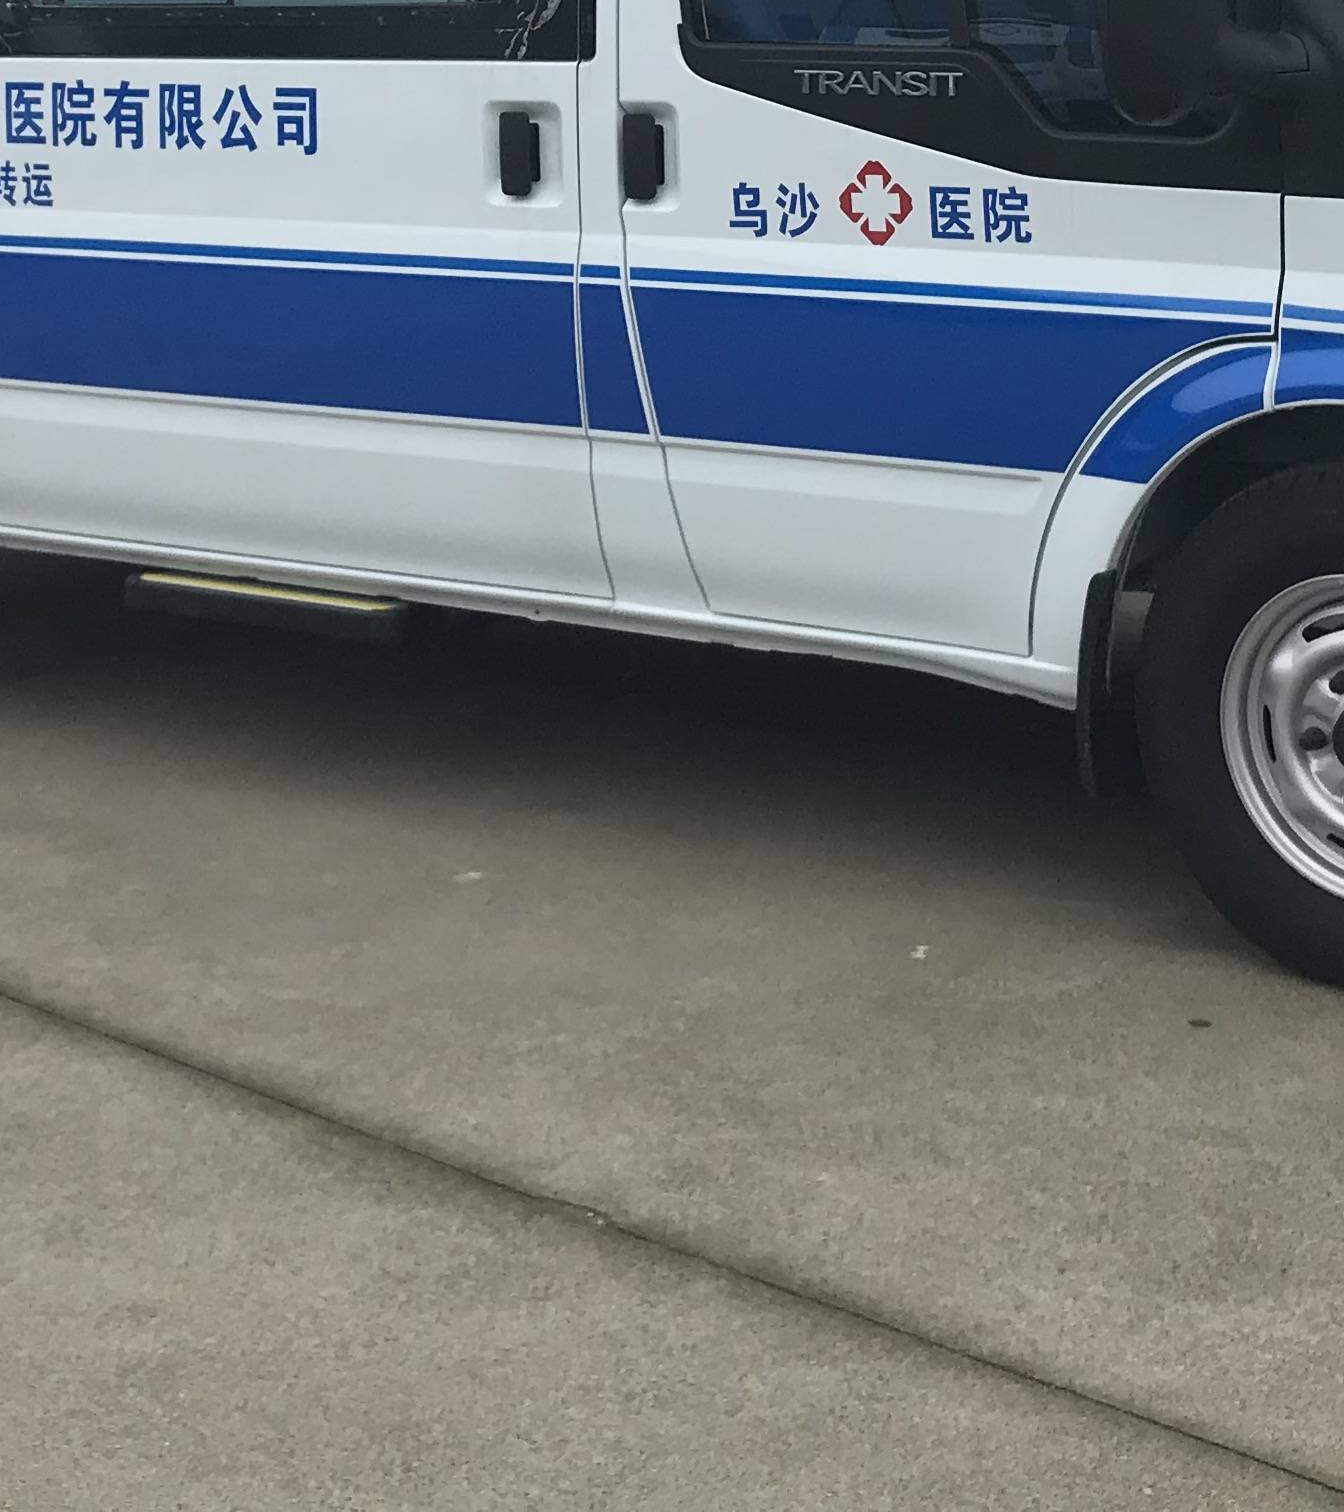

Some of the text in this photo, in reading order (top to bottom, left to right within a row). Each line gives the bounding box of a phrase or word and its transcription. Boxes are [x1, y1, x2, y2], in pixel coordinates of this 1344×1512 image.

[793, 68, 964, 97] TRANSIT
[729, 182, 1033, 243] 乌沙 医院
